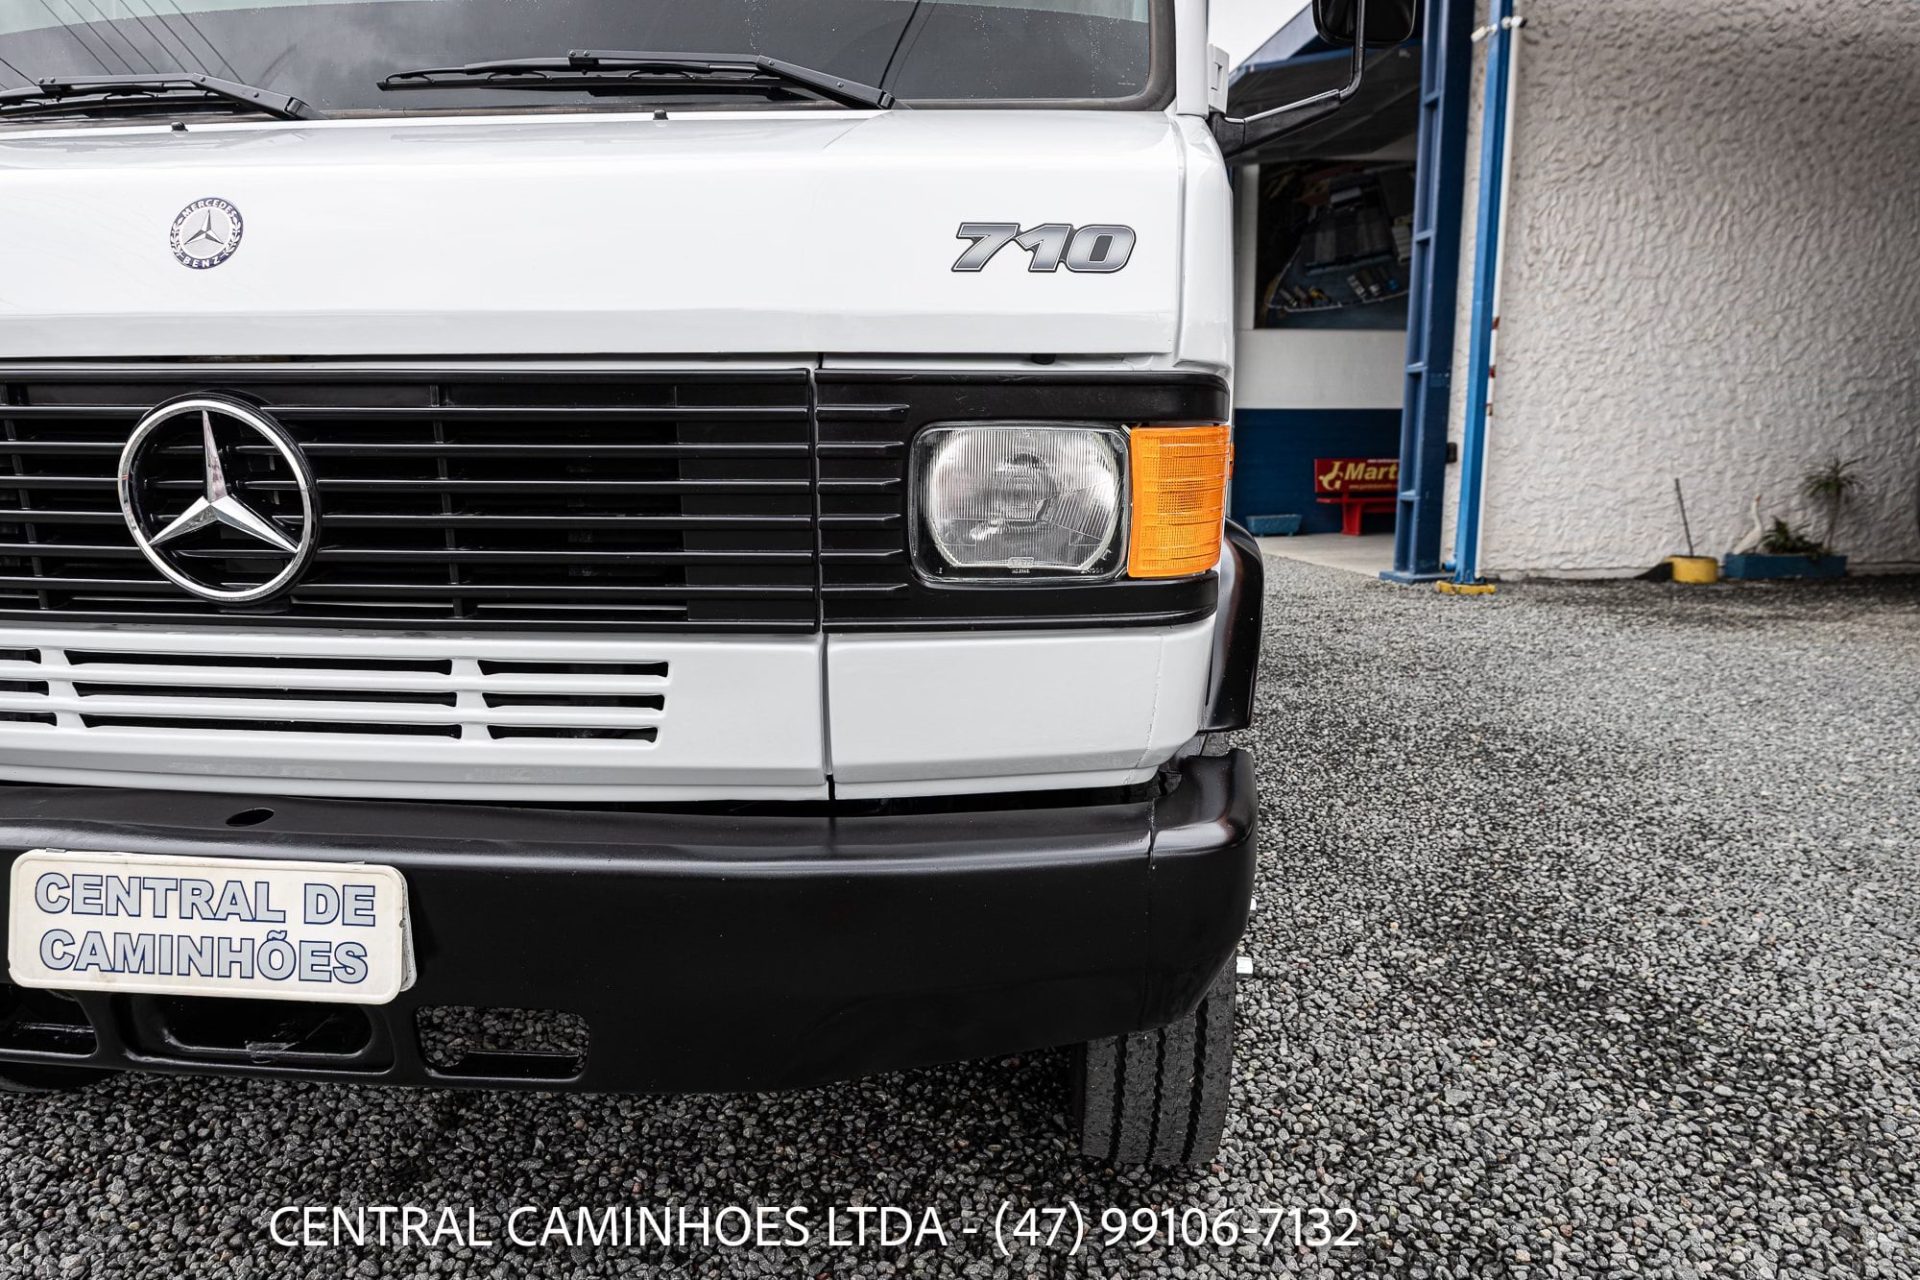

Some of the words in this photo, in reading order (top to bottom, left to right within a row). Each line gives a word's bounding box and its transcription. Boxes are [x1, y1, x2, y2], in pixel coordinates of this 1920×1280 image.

[181, 199, 237, 218] MERCEDES
[183, 255, 221, 268] BENZ
[951, 222, 1136, 273] 710
[35, 872, 286, 923] CENTRAL
[304, 883, 376, 927] DE
[40, 929, 368, 984] CAMINHÕES
